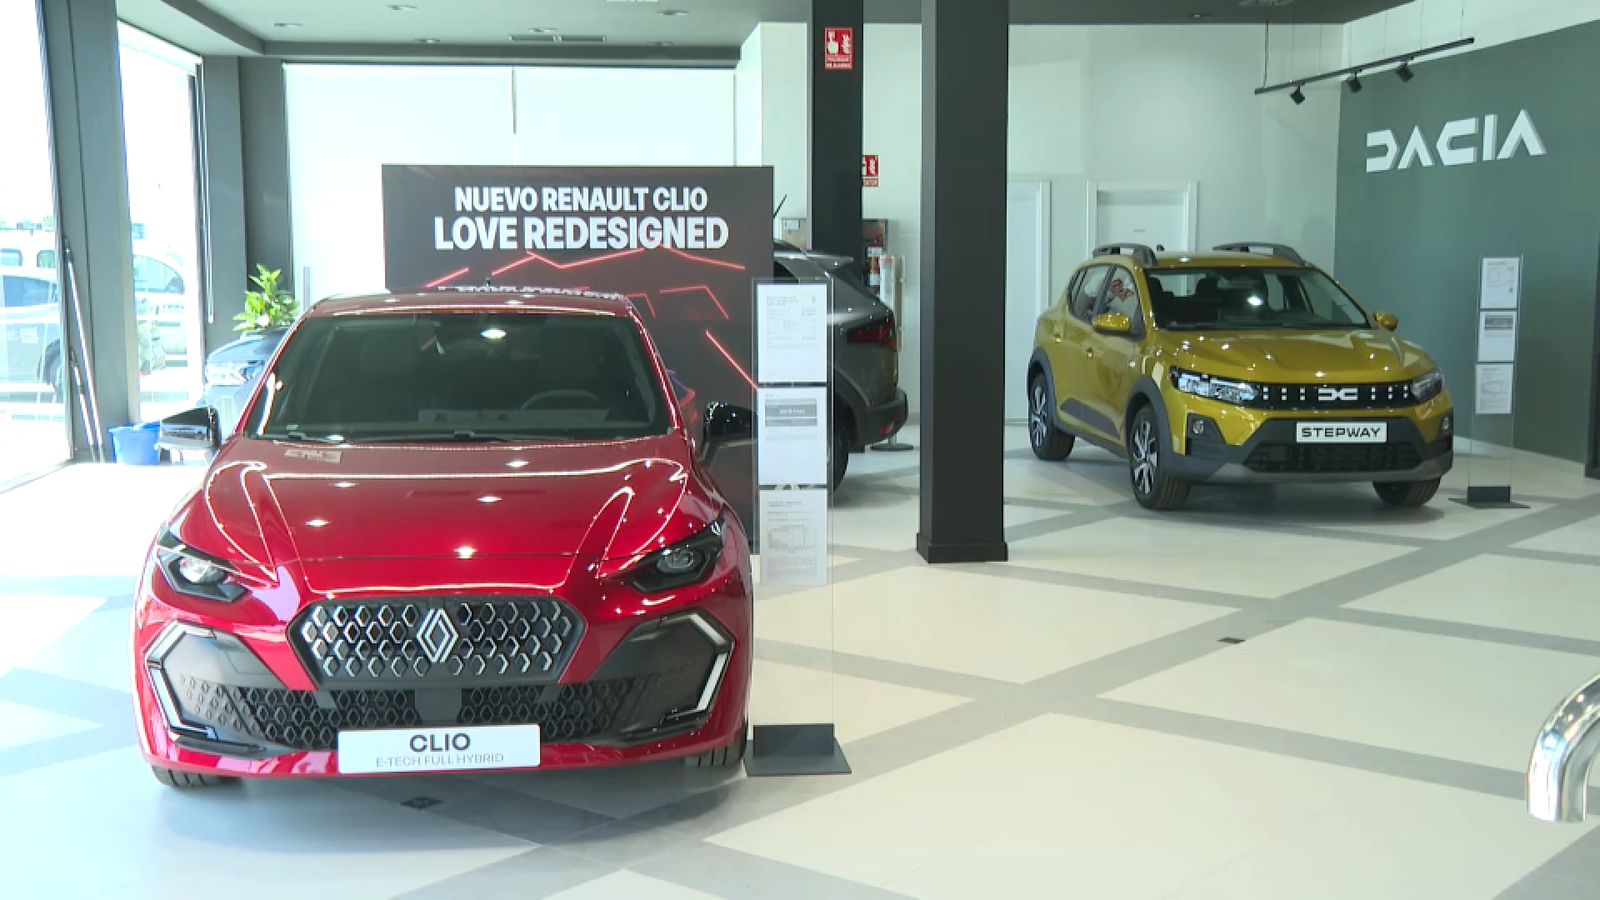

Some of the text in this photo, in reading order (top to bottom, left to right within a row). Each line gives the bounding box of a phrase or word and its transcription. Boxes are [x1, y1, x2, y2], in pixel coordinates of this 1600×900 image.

[1366, 108, 1547, 173] DACIA
[454, 187, 708, 212] NUEVO RENAULT CLIO
[434, 216, 729, 251] LOVE REDESIGNED
[1301, 427, 1381, 438] STEPWAY
[409, 733, 471, 752] CLIO
[376, 753, 504, 768] E-TECH FULL HYBRID
